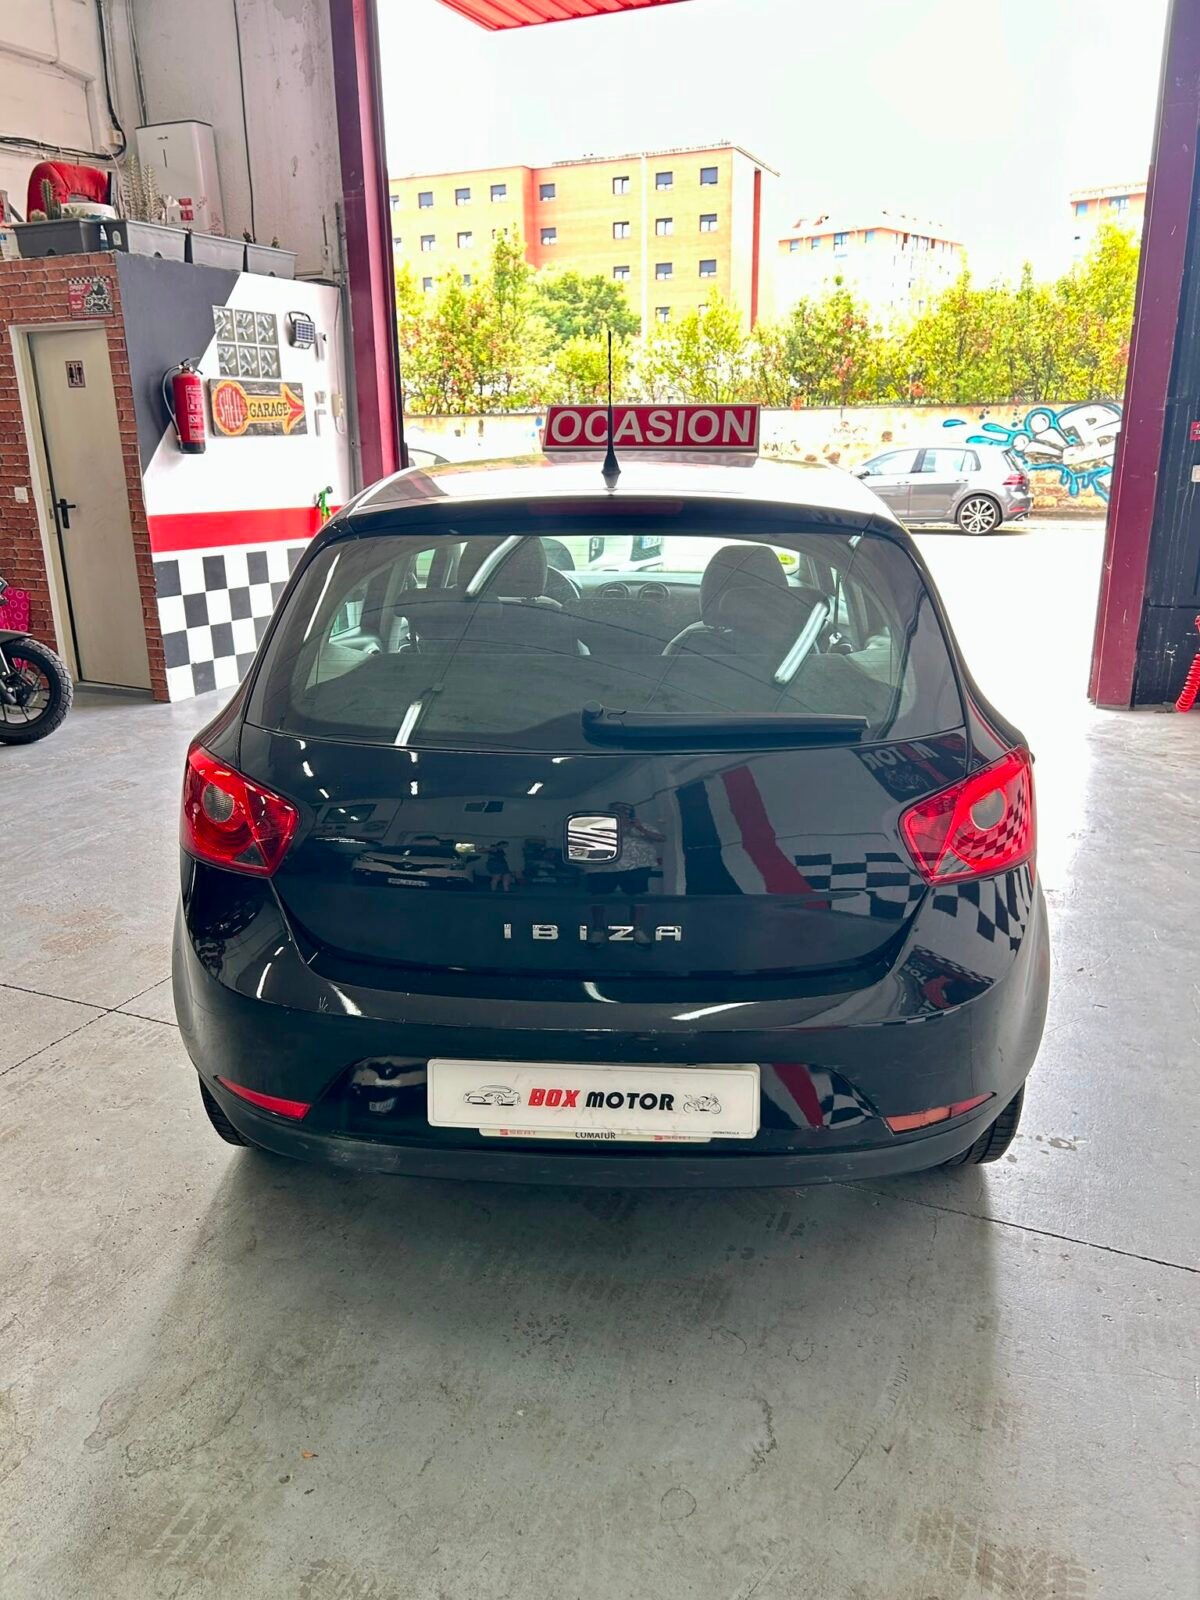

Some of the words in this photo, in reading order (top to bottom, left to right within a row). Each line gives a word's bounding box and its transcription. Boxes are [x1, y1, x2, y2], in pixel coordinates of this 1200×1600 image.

[249, 402, 289, 418] GARAGE
[551, 409, 751, 443] OCASION
[503, 923, 682, 941] IBIZA
[528, 1088, 581, 1108] BOX
[585, 1091, 675, 1111] MOTOR
